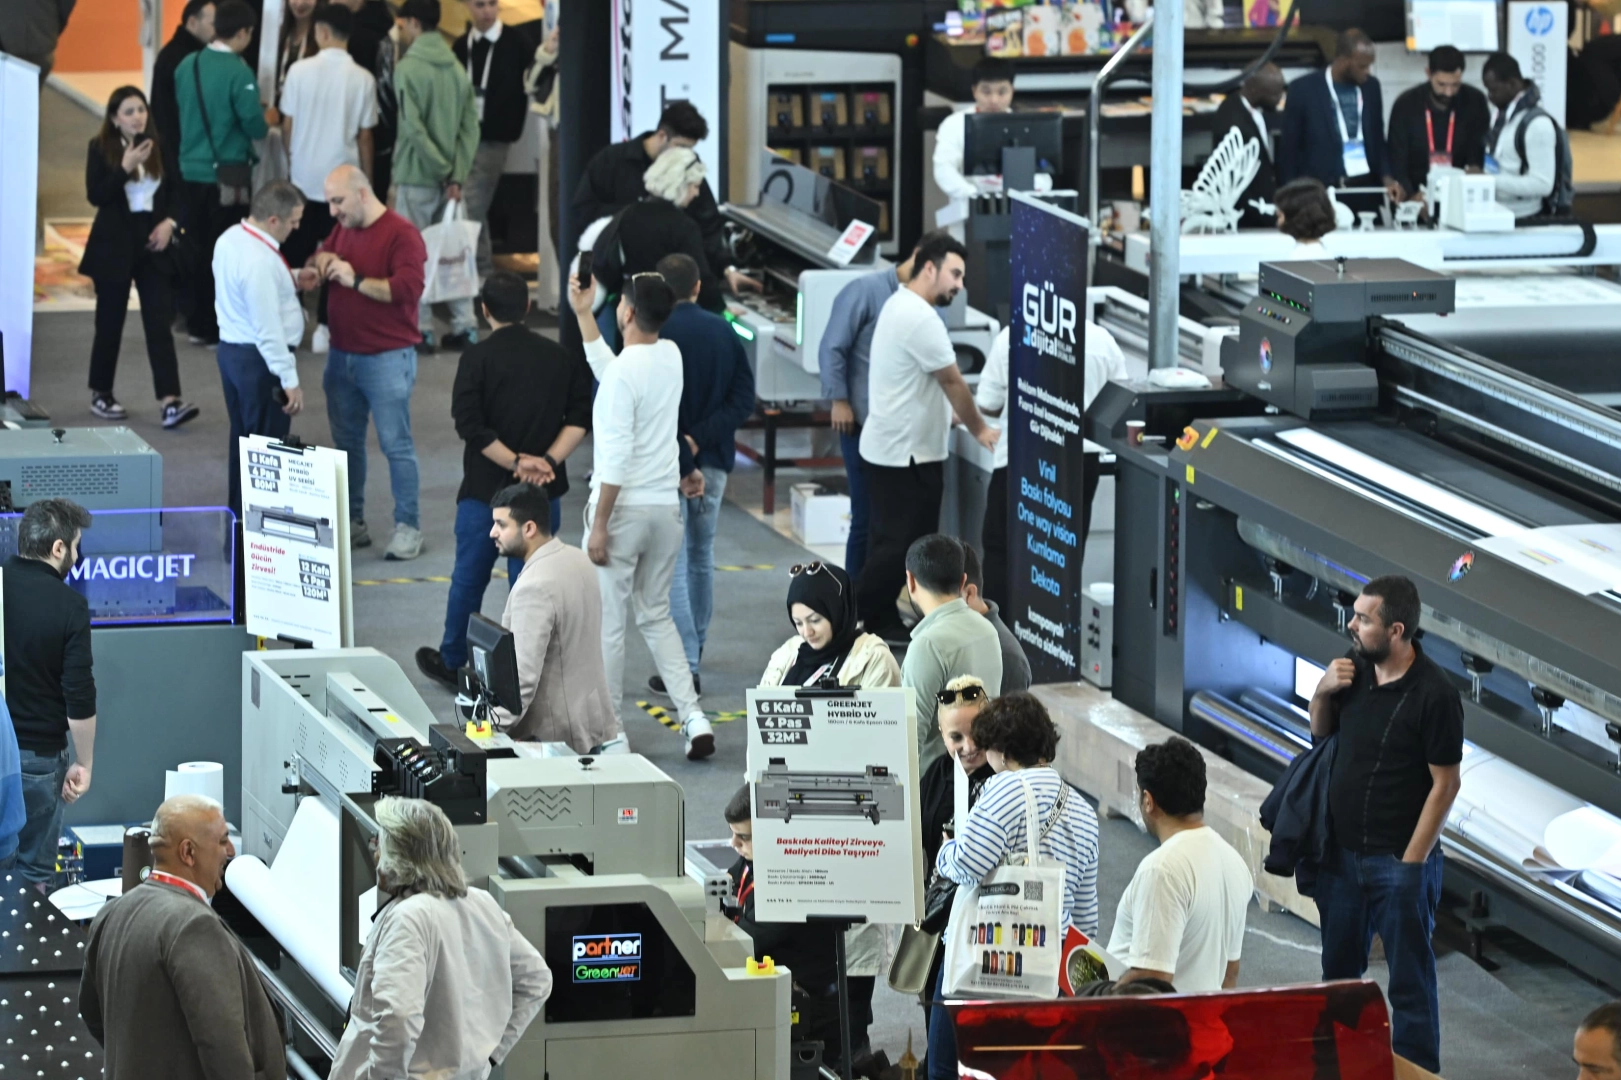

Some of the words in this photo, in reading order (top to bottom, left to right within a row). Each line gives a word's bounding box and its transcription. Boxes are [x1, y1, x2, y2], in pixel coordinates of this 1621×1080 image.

[1022, 280, 1076, 344] GÜR
[1030, 328, 1057, 357] dijital
[252, 452, 258, 463] 8
[259, 454, 279, 467] Kafa
[288, 459, 313, 468] MEGAJET
[252, 466, 259, 476] 4
[260, 468, 276, 480] Pas
[1038, 458, 1056, 483] Vinil
[1021, 476, 1042, 502] Baskı
[1043, 486, 1072, 518] folyosu
[1018, 502, 1034, 526] One
[1035, 514, 1052, 538] way
[1053, 522, 1076, 547] vision
[250, 542, 286, 556] Endüstride
[1027, 532, 1065, 568] Kumlama
[251, 553, 272, 563] Gücün
[64, 554, 196, 583] MAGICJET
[251, 563, 276, 574] Zirvesi!
[301, 561, 310, 572] 12
[312, 563, 330, 576] Kafa
[303, 574, 309, 583] 4
[310, 576, 326, 588] Pas
[1031, 565, 1060, 596] Dekota
[761, 701, 770, 713] 6
[774, 701, 804, 713] Kafa
[827, 700, 872, 708] GREENJET
[827, 710, 862, 718] HYBRİD
[765, 717, 774, 728] 4
[778, 717, 802, 728] Pas
[767, 732, 800, 743] 32M²
[776, 838, 813, 846] Baskıda
[814, 838, 849, 848] Kaliteyi
[850, 838, 886, 848] Zirveye,
[784, 847, 820, 858] Maliyeti
[821, 848, 841, 856] Dibe
[843, 848, 880, 858] Taşıyın!
[572, 936, 640, 961] partner
